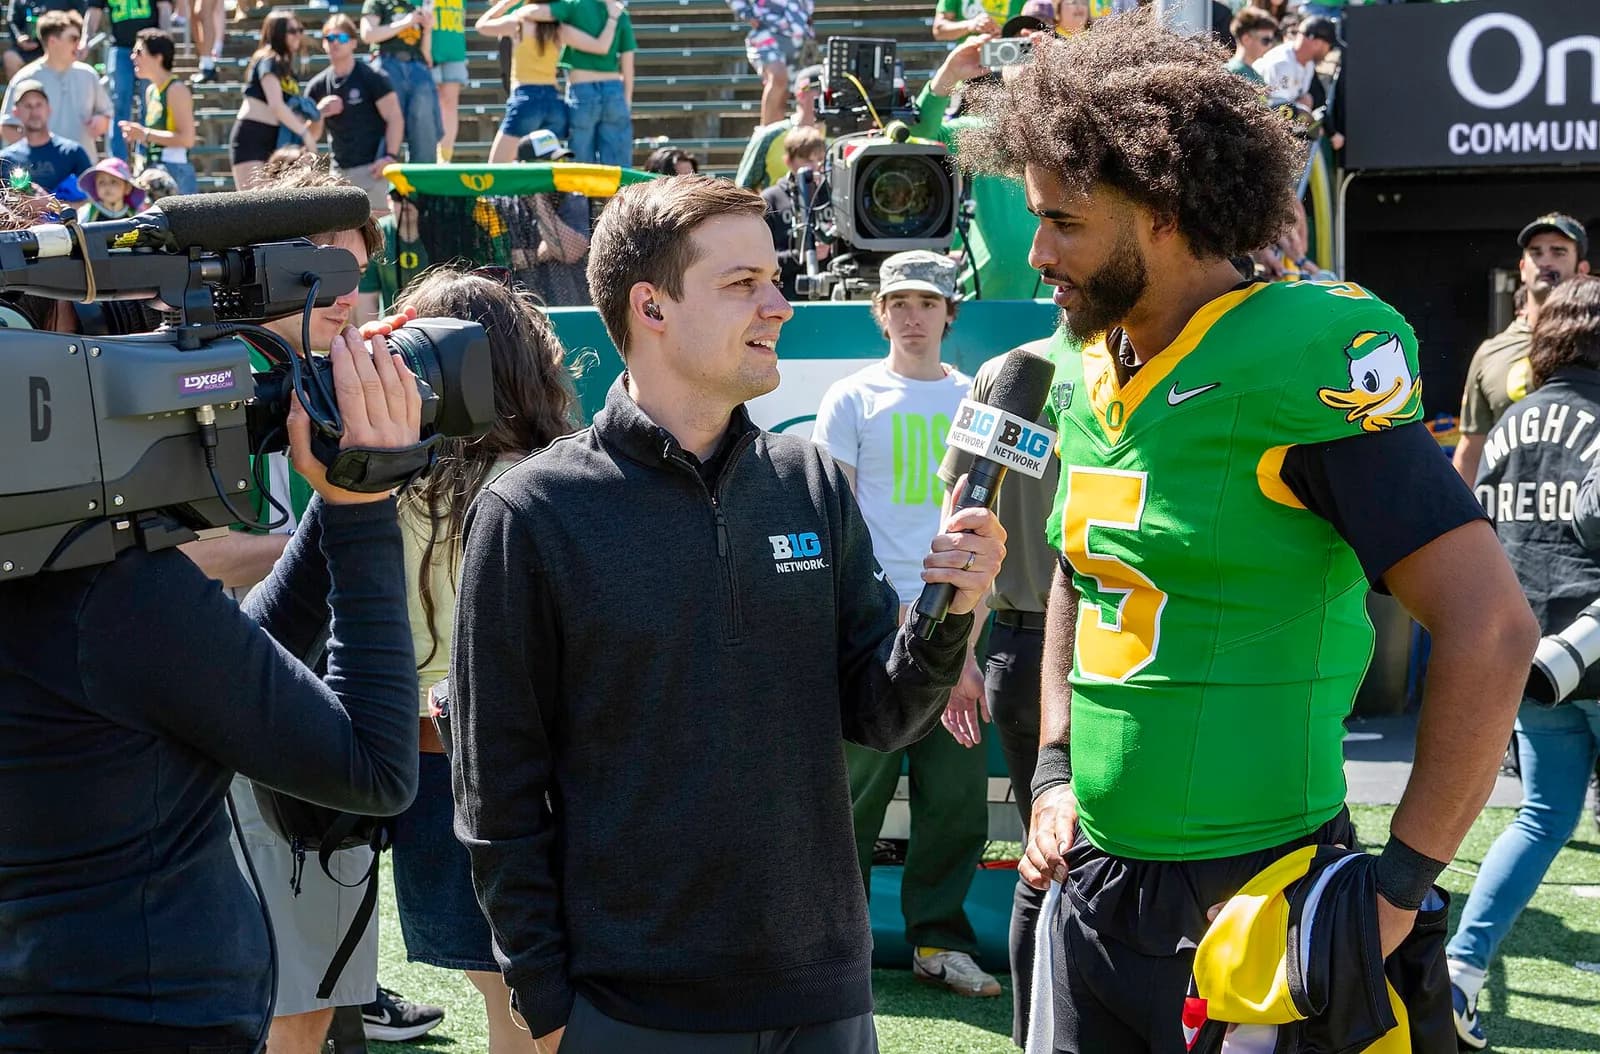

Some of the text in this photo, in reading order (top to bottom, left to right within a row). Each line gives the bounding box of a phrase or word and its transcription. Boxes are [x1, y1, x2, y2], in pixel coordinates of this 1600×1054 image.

[1447, 12, 1600, 109] On
[951, 431, 985, 450] NETWORK
[1062, 465, 1168, 683] 5
